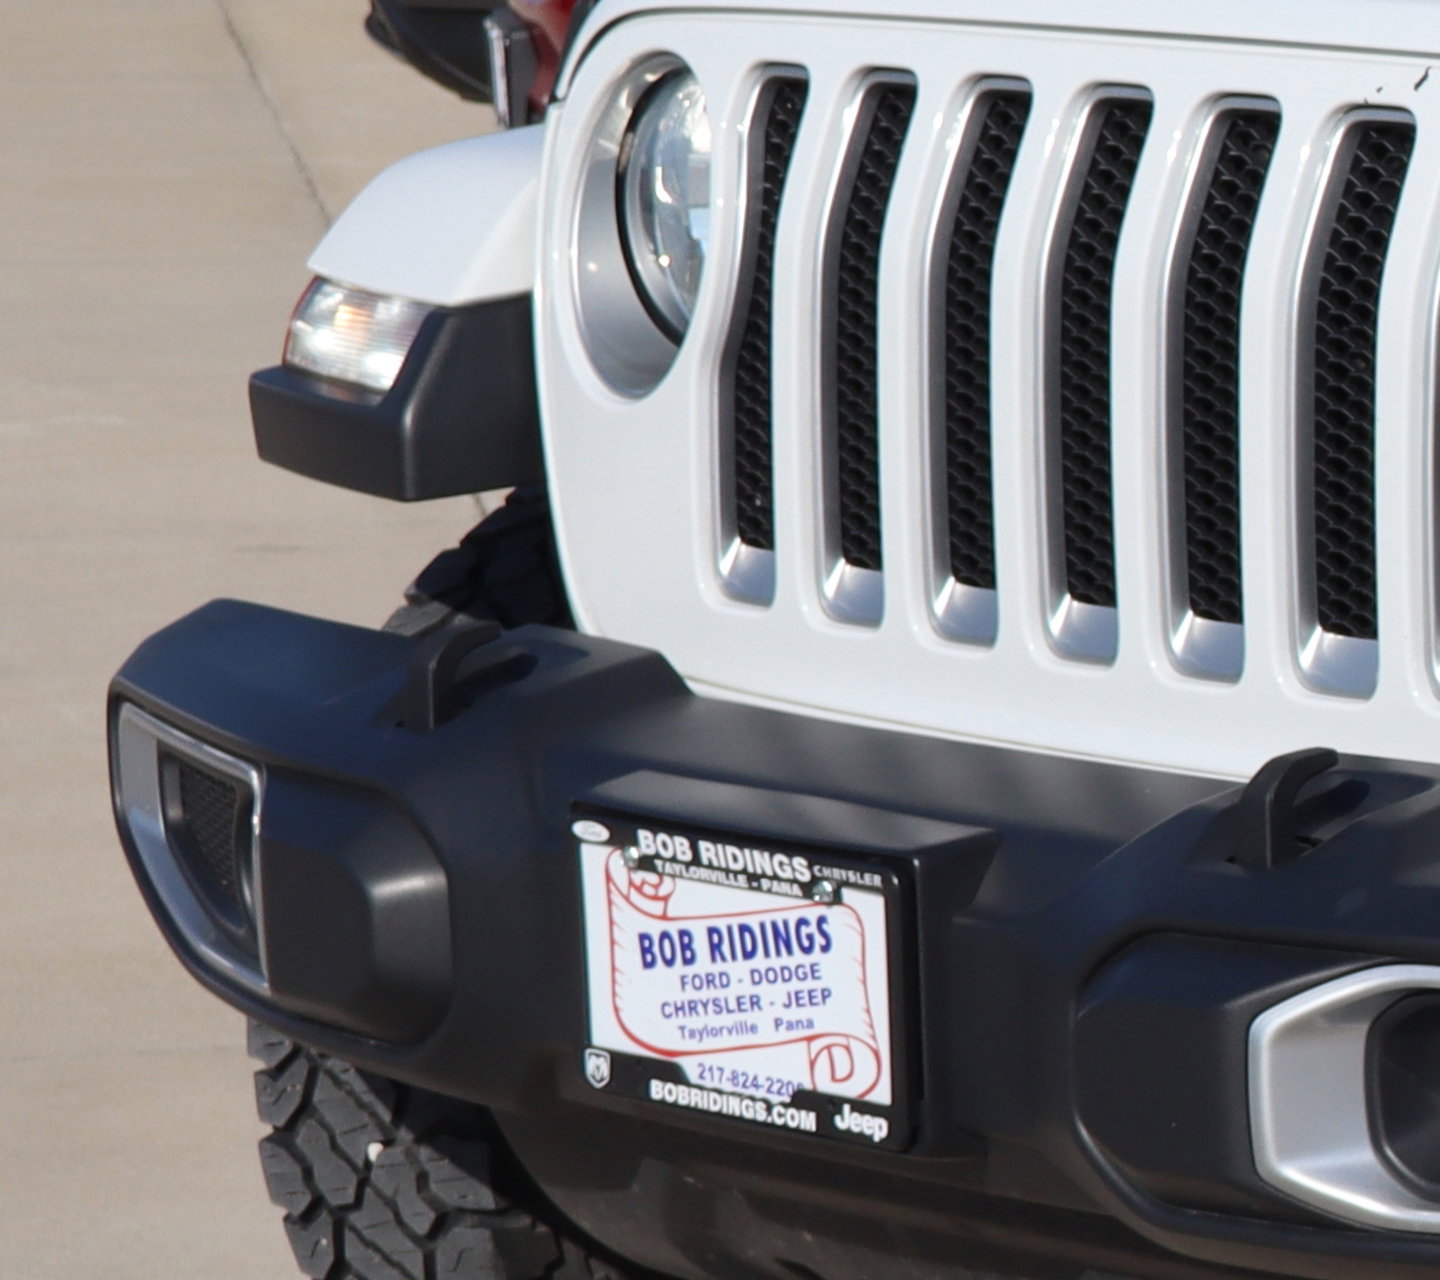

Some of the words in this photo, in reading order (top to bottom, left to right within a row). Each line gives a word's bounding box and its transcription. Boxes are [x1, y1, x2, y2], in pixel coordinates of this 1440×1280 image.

[637, 829, 693, 862] BOB
[698, 840, 812, 882] RIDINGS
[654, 859, 749, 889] TAYLORVILLE
[760, 878, 803, 898] PANA
[813, 864, 882, 888] CHRYSLER
[638, 928, 697, 970] BOB
[707, 914, 833, 964] RIDINGS
[680, 970, 731, 992] FORD
[750, 963, 823, 985] DODGE
[661, 990, 763, 1019] CHRYSLER
[782, 988, 832, 1010] JEEP
[678, 1020, 759, 1042] Taylorville
[774, 1017, 814, 1033] Pana
[650, 1078, 817, 1133] BOBRIDINGS.COM
[833, 1103, 889, 1143] Jeep
